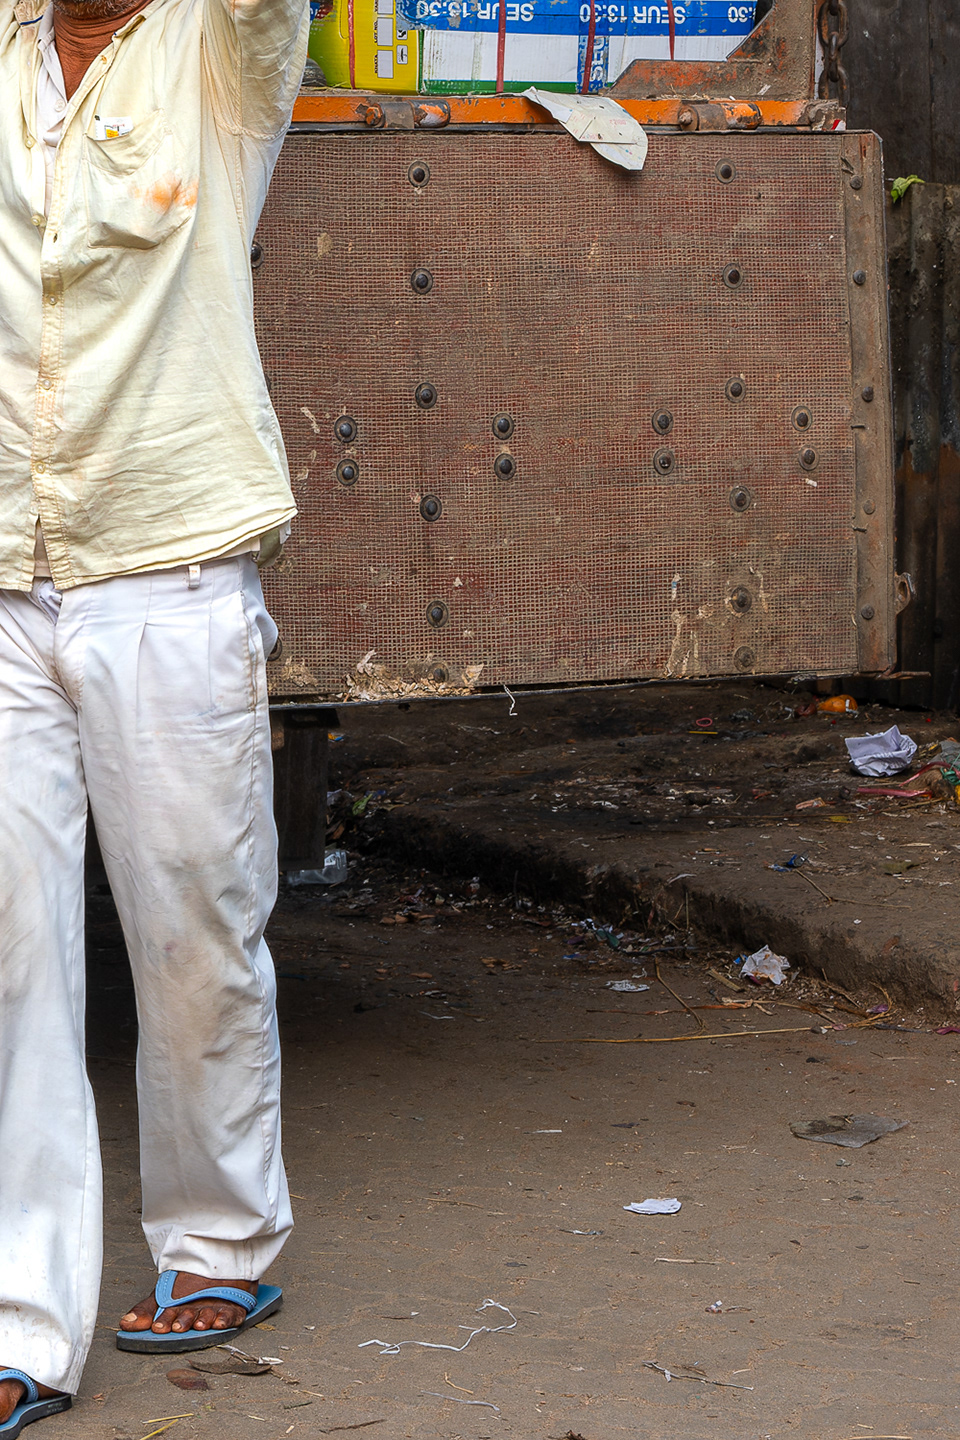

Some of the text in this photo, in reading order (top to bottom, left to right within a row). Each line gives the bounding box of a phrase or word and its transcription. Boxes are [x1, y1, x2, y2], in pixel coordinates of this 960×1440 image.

[477, 2, 535, 22] SEUR
[579, 3, 686, 24] SEUR 13:30
